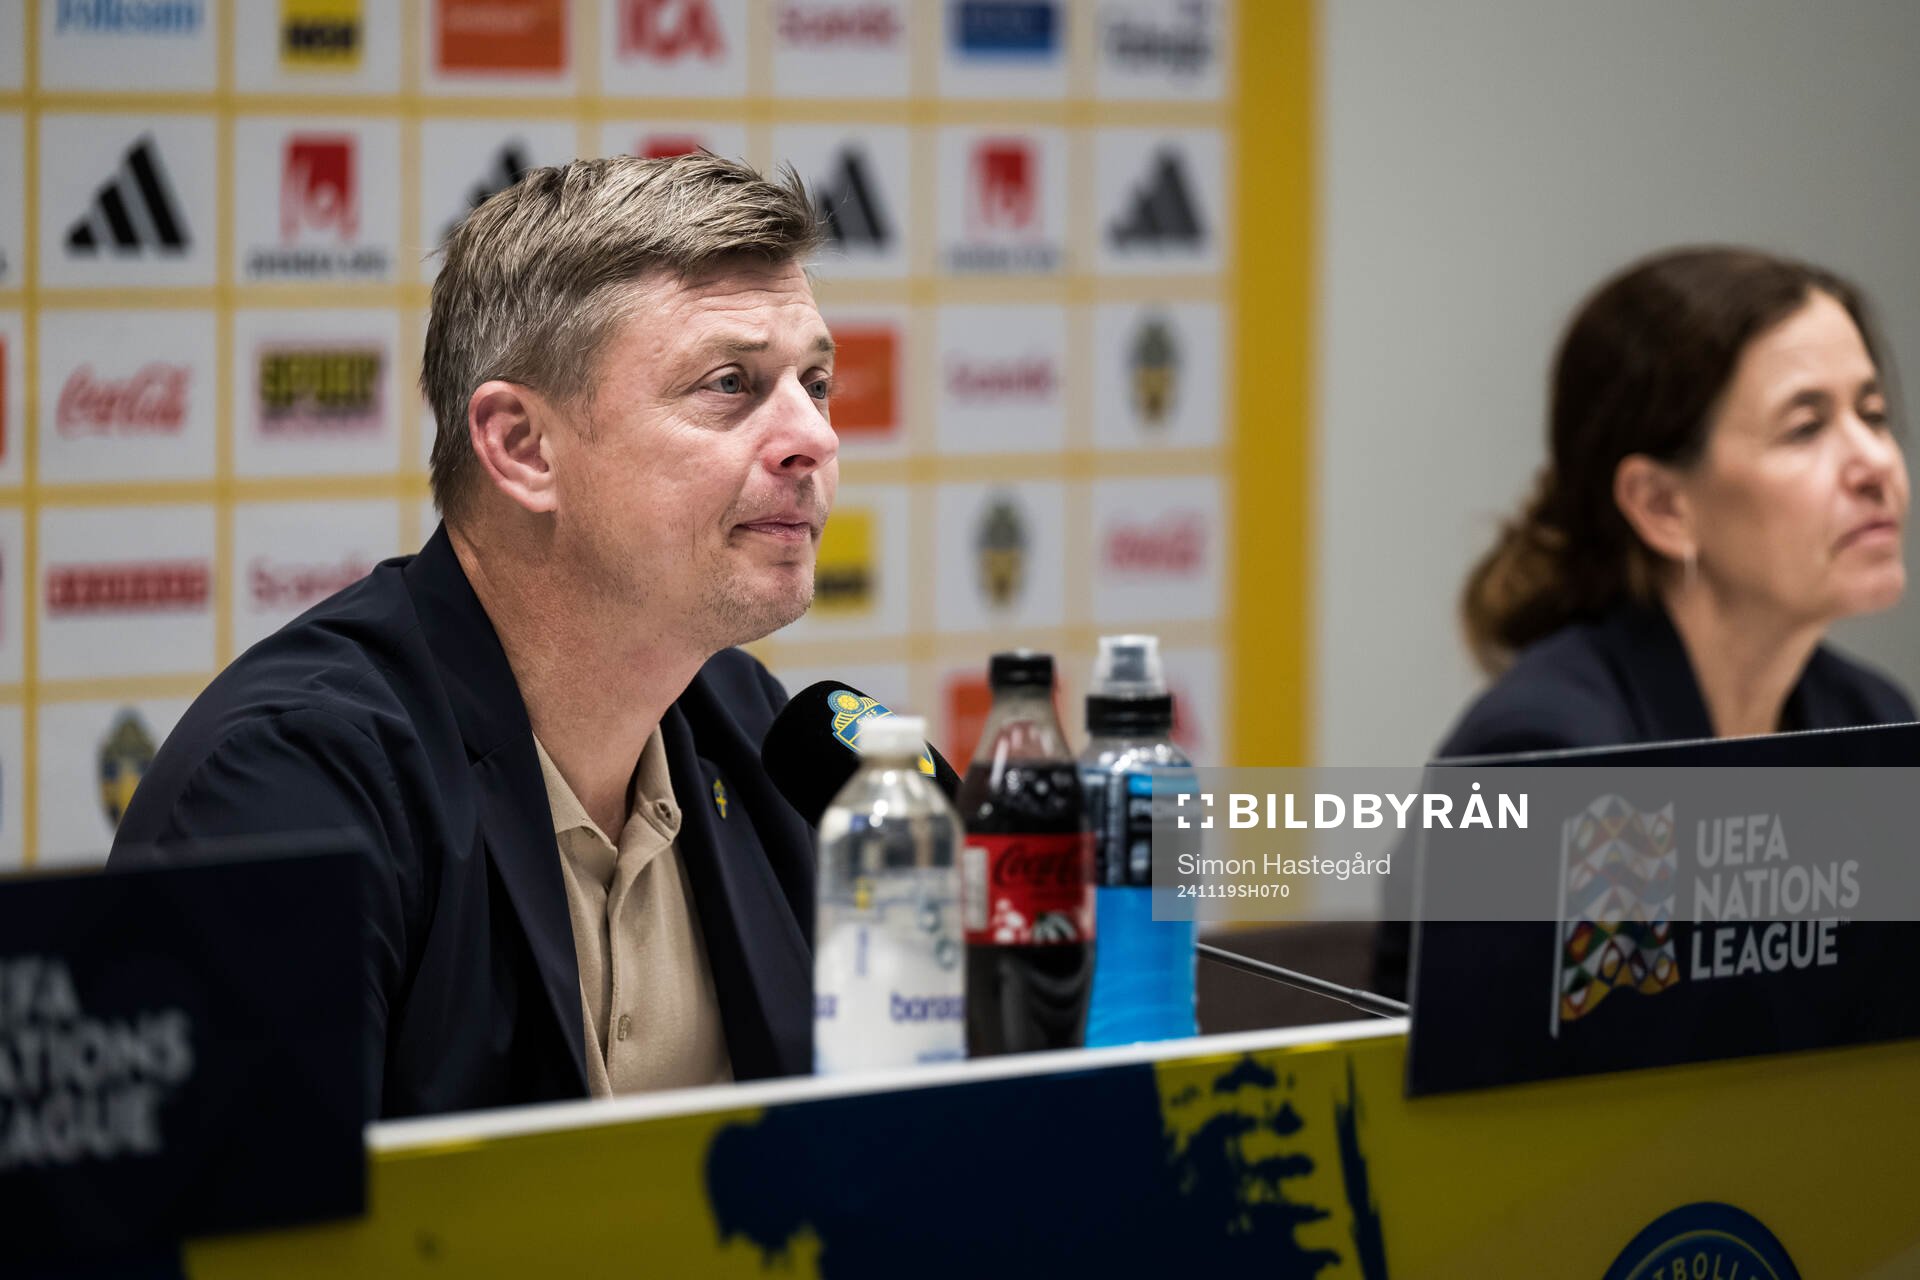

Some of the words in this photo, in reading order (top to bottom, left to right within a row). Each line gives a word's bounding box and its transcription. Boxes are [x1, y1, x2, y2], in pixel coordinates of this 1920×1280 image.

[1696, 813, 1789, 868] UEFA
[1693, 860, 1860, 925] NATIONS
[1690, 917, 1838, 981] LEAGUE
